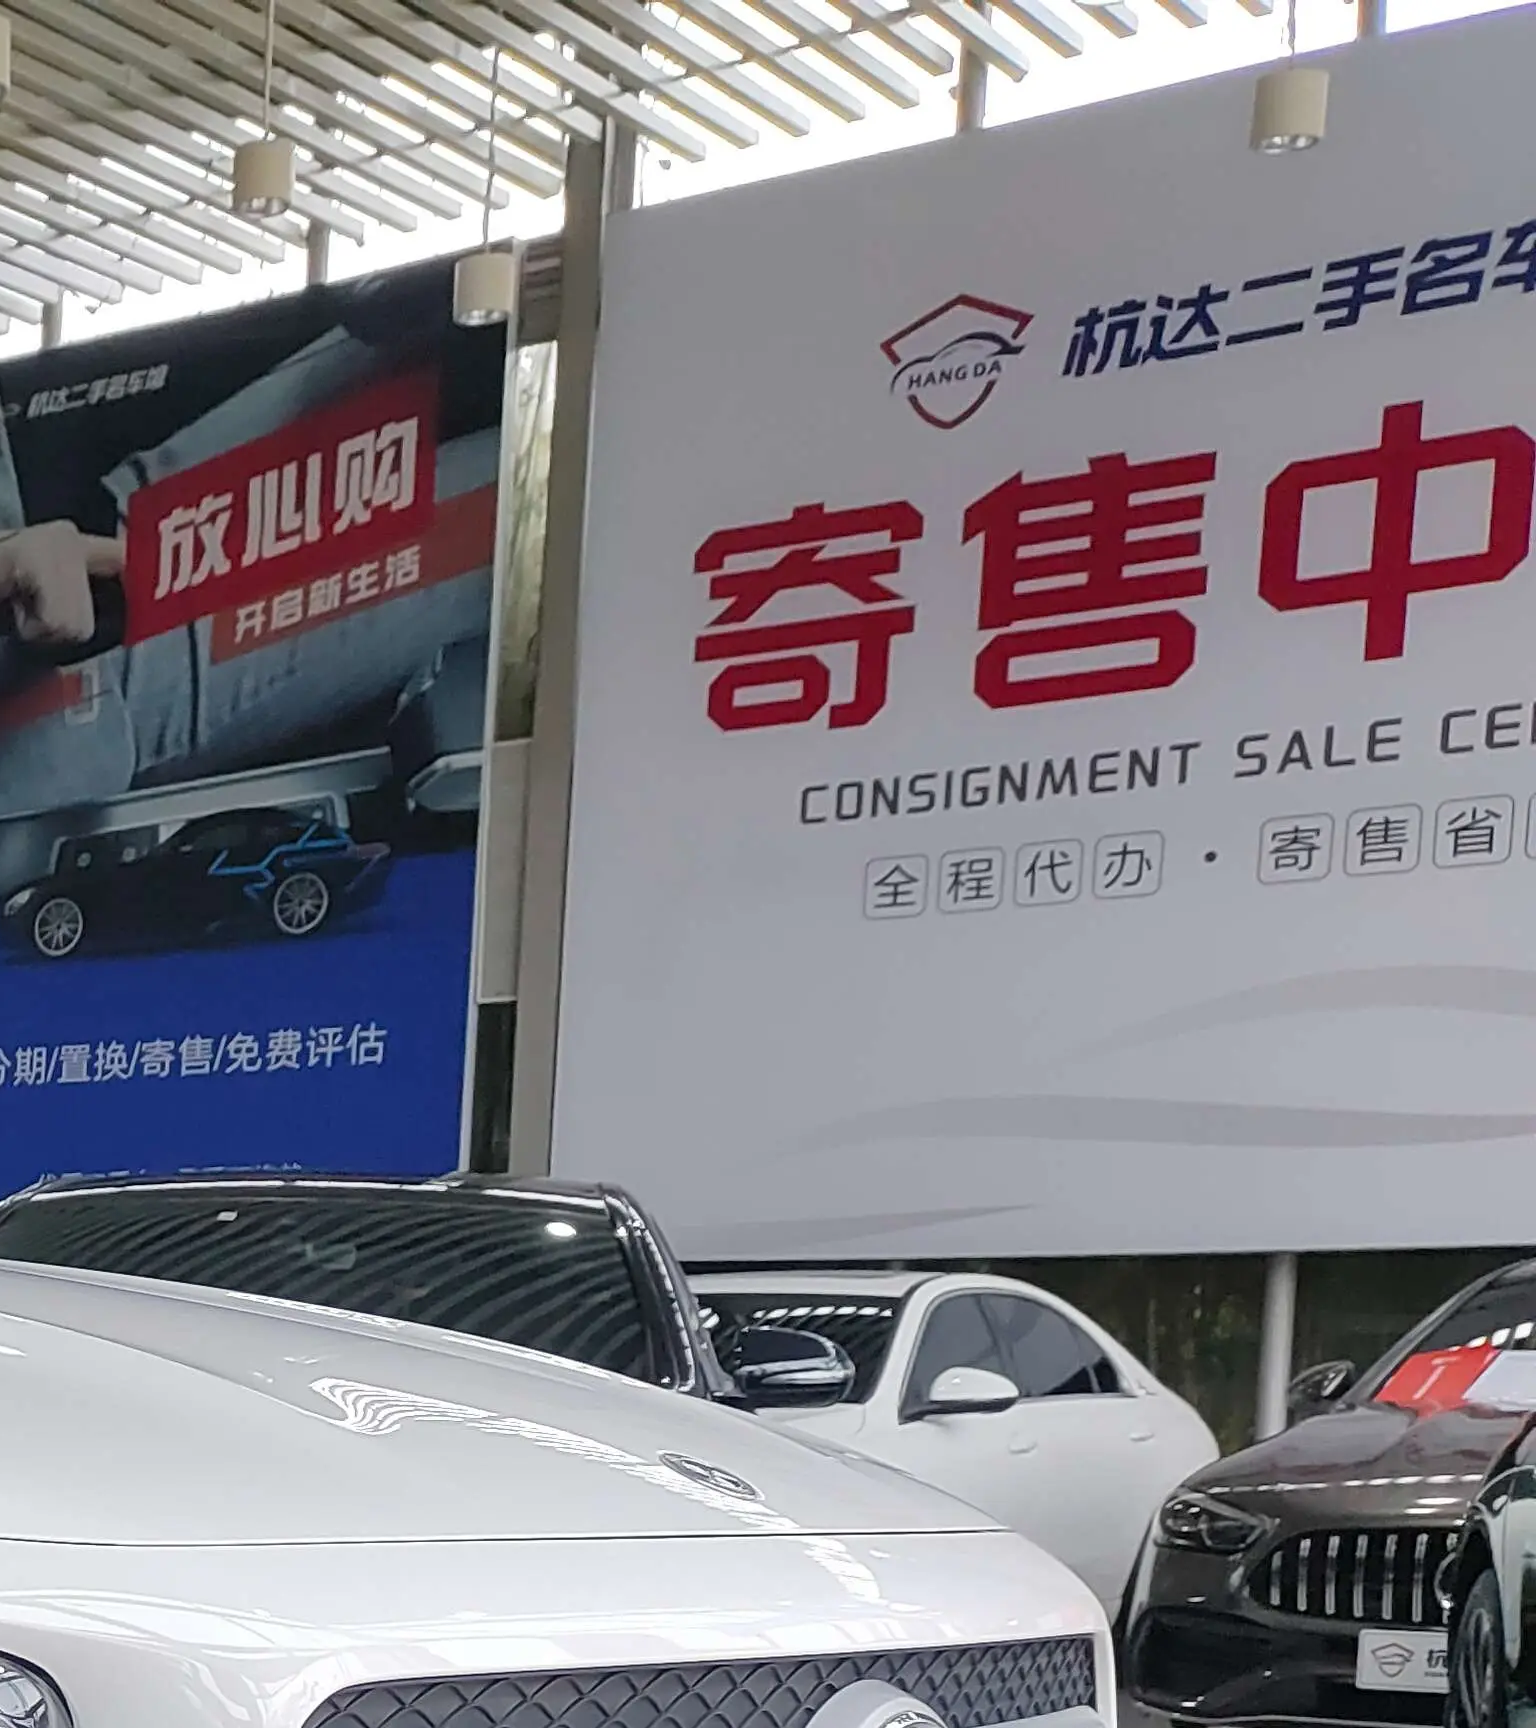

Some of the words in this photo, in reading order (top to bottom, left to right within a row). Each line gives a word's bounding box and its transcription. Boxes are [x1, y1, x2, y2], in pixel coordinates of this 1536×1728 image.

[908, 364, 968, 391] HANG
[973, 359, 1002, 379] DA
[154, 416, 419, 600] 放心购
[693, 400, 1536, 732] 寄售中
[234, 544, 422, 644] 开启新生活
[798, 741, 1202, 825] CONSIGNMENT
[1233, 717, 1404, 779] SALE
[1439, 702, 1536, 756] CE
